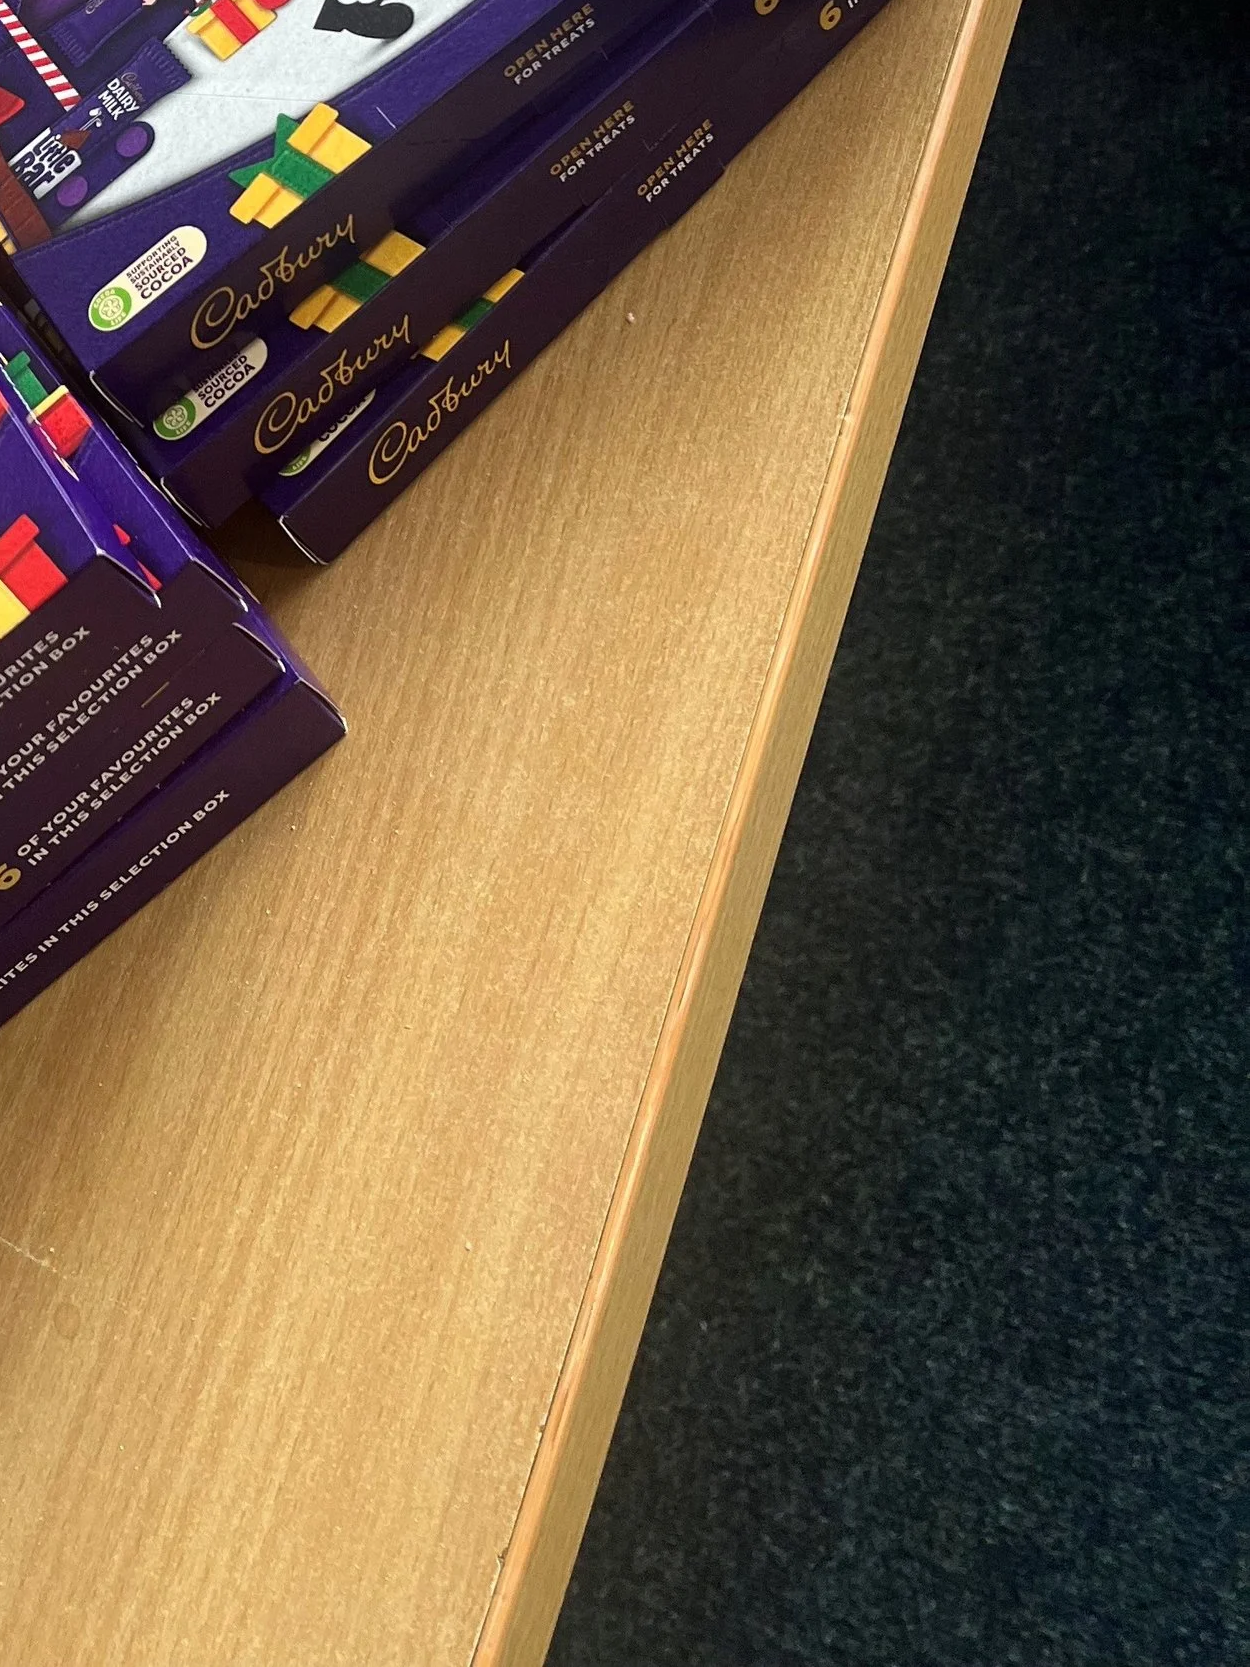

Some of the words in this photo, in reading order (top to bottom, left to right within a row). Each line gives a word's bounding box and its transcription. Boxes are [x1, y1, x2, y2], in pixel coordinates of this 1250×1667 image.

[127, 236, 177, 278] SUPPORTING
[131, 241, 182, 283] SUSTAINABLY
[135, 248, 185, 290] SOURCED
[141, 256, 193, 299] COCOA
[193, 214, 355, 348] Cadbury
[256, 315, 410, 454] Cadbury
[369, 340, 511, 484] Cadbury
[46, 635, 152, 732] FAVOURITES
[49, 627, 90, 661] BOX
[2, 753, 45, 788] THIS
[47, 664, 142, 753] SELECTION
[143, 630, 181, 664] BOX
[38, 935, 58, 952] IN
[58, 901, 98, 932] THIS
[100, 821, 192, 900] SELECTION
[193, 790, 229, 821] BOX
